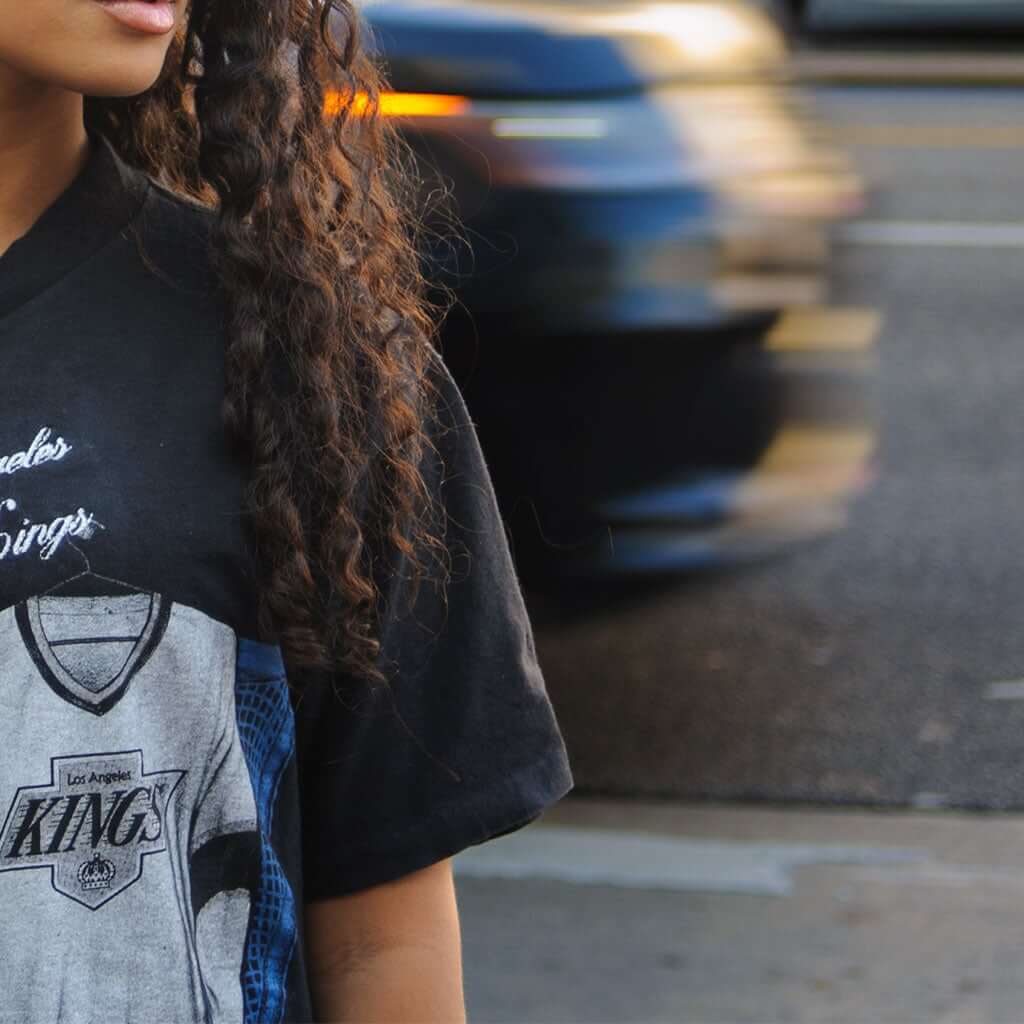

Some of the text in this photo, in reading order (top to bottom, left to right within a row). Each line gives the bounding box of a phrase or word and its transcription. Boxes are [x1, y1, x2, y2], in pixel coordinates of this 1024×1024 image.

[67, 770, 131, 786] Los Angeles
[4, 783, 170, 859] KINGS
